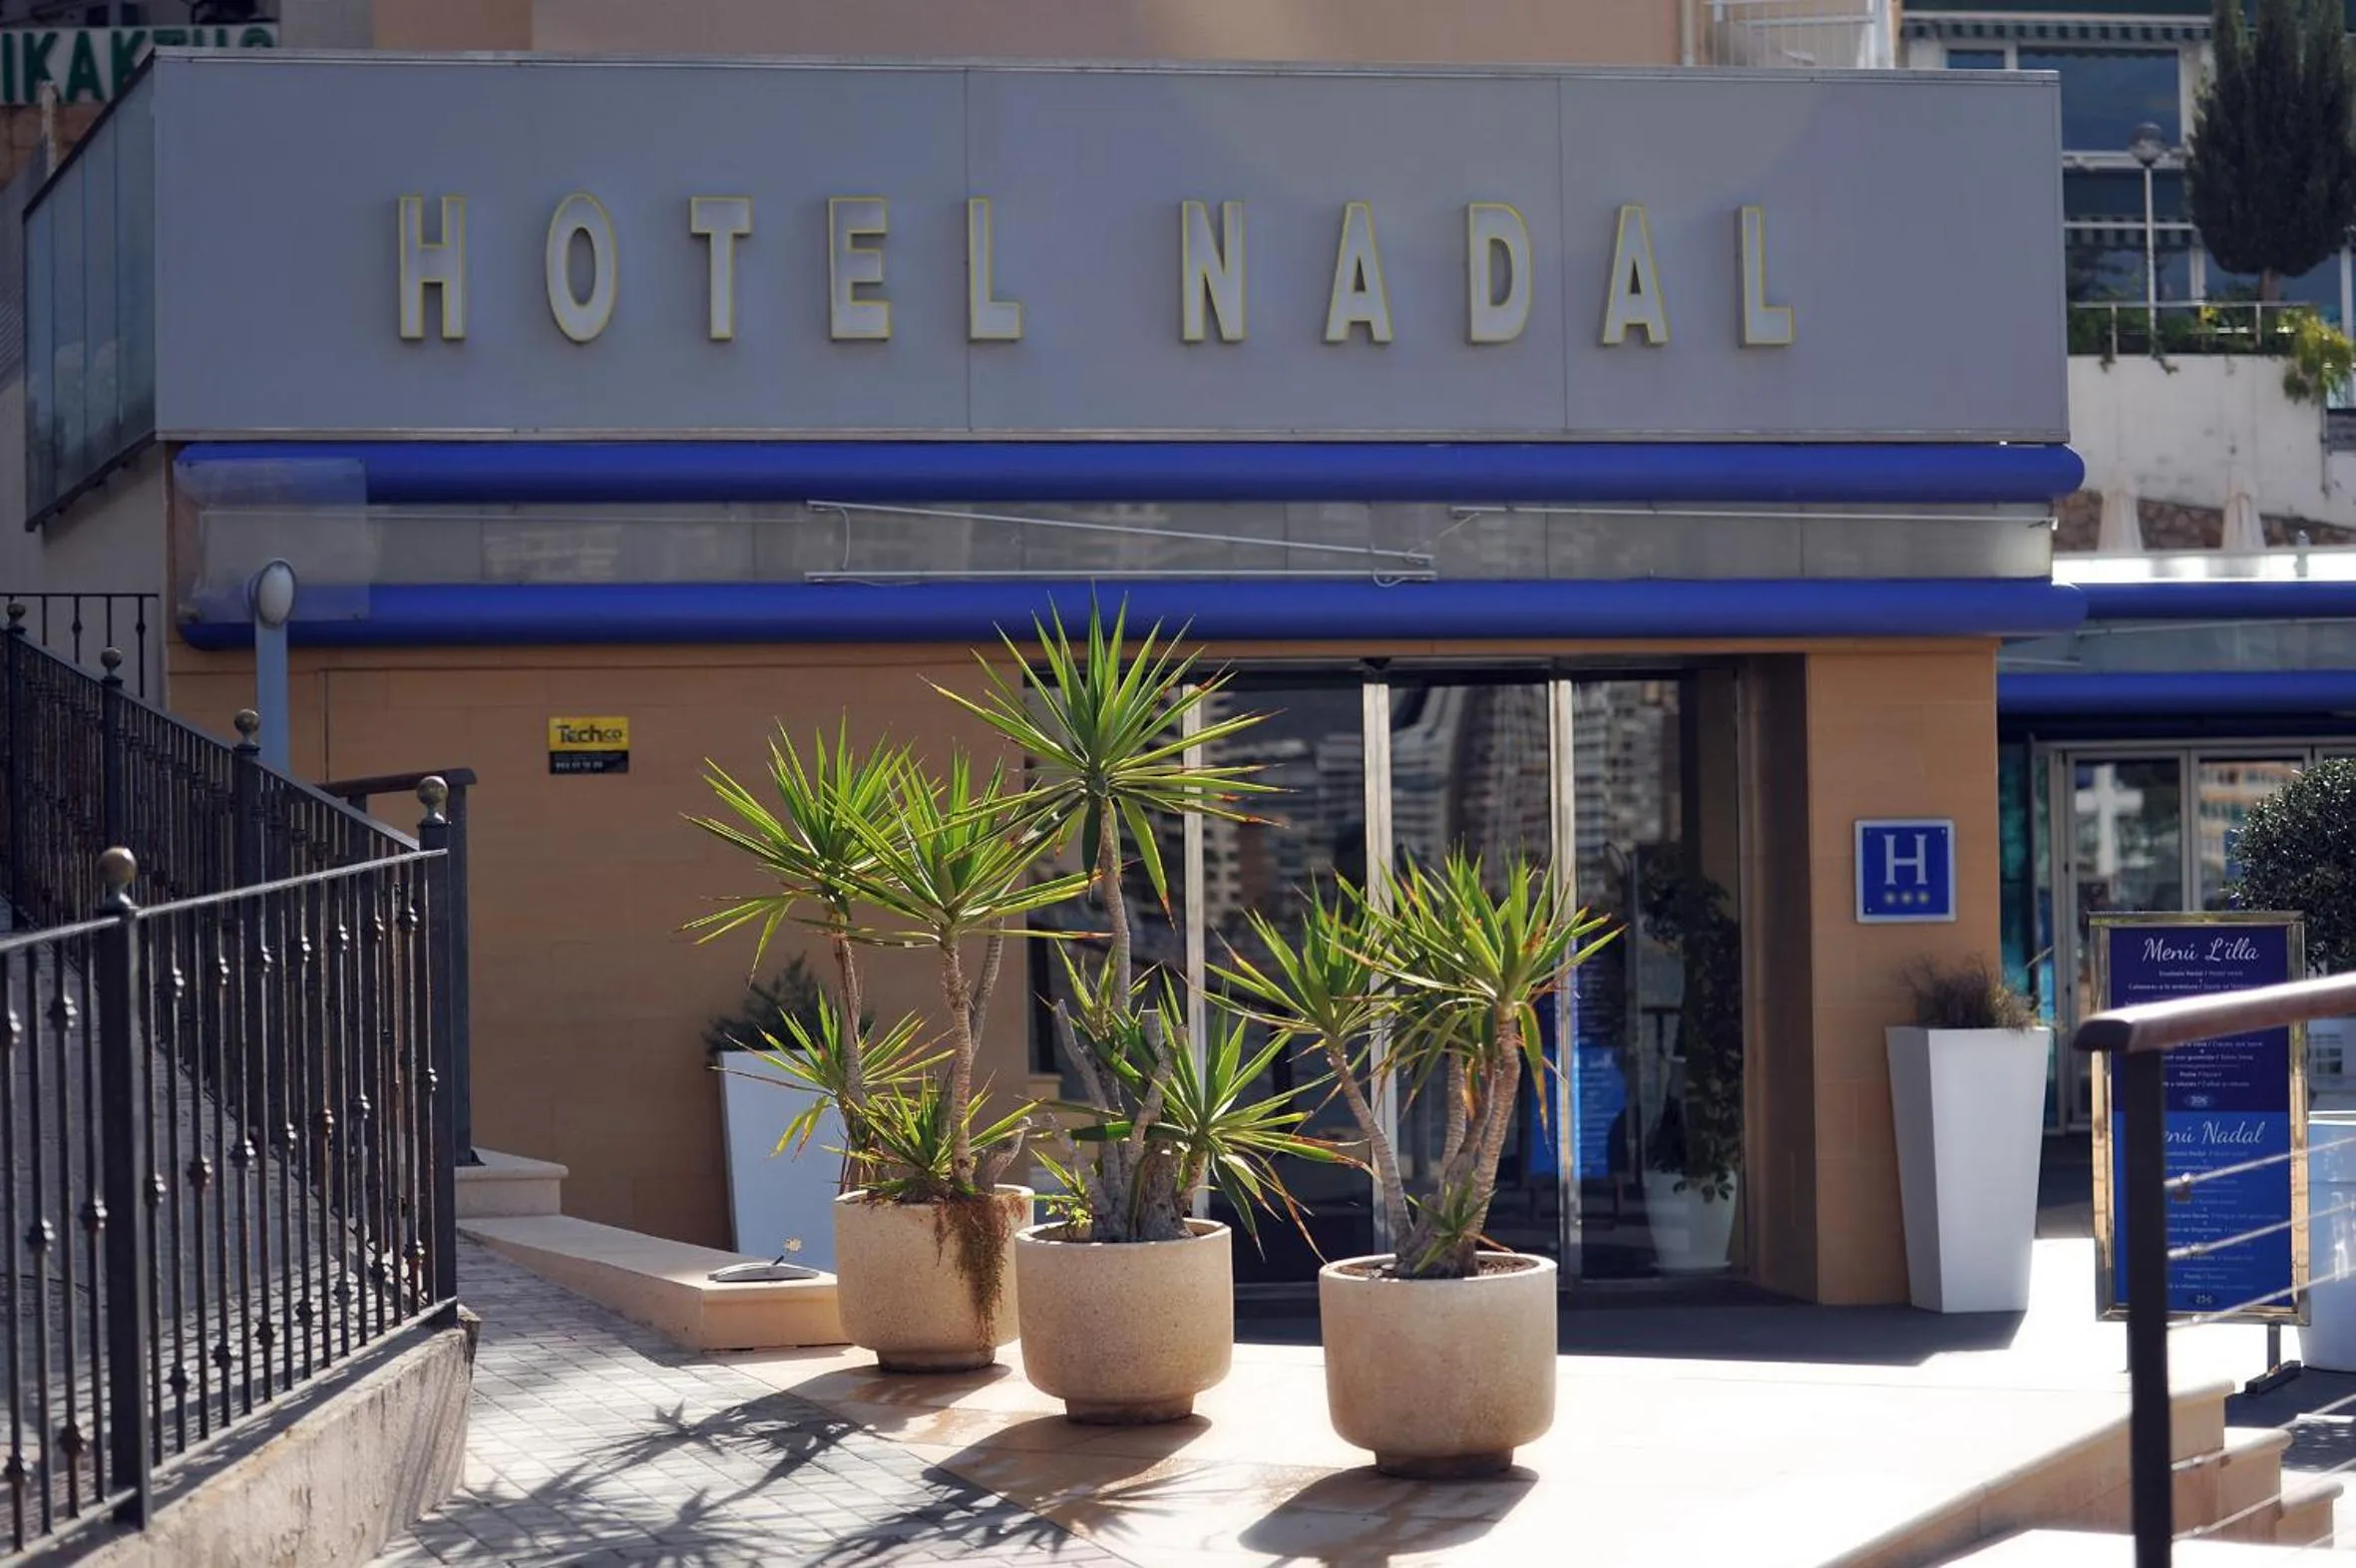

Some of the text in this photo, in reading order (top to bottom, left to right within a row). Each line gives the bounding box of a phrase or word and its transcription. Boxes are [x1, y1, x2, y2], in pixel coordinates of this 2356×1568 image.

[2, 27, 274, 103] IKAK
[396, 193, 1793, 347] HOTEL NADAL
[1883, 834, 1928, 885] H
[2143, 937, 2198, 963] Menú
[2201, 1120, 2266, 1146] Nadal
